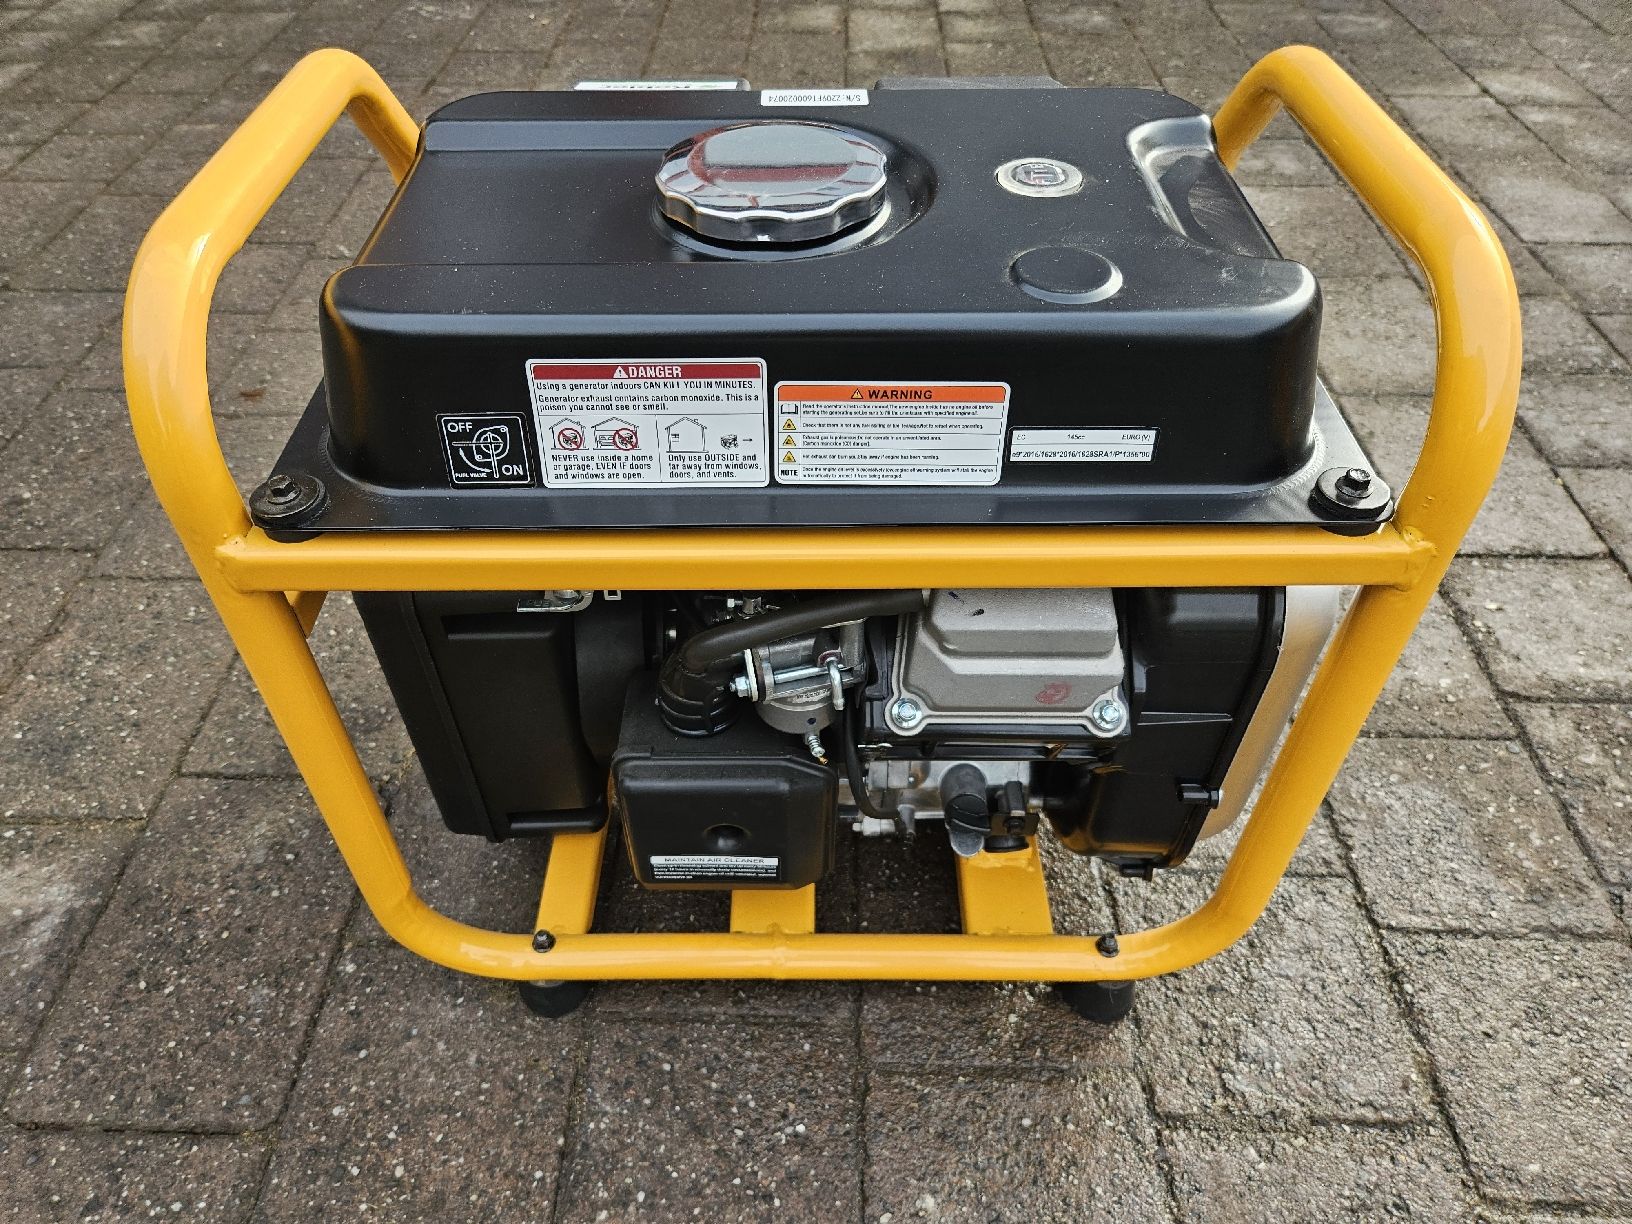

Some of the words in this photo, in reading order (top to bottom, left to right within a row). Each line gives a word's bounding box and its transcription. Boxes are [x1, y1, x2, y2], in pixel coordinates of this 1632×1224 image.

[628, 366, 682, 378] DANGER
[536, 382, 560, 391] Using
[570, 382, 609, 391] generator
[611, 381, 642, 389] indoors
[643, 381, 661, 389] CAN
[684, 381, 702, 389] YOU
[704, 381, 712, 389] IN
[715, 380, 756, 389] MINUTES.
[539, 395, 579, 403] Generator
[614, 394, 649, 402] contains
[651, 394, 679, 402] carbon
[681, 394, 724, 402] monoxide.
[868, 389, 933, 400] WARNING
[540, 404, 567, 412] poison
[570, 404, 584, 412] you
[586, 403, 613, 411] cannot
[643, 403, 669, 411] smell.
[447, 422, 473, 432] OFF
[597, 454, 622, 462] inside
[631, 454, 653, 462] home
[668, 455, 686, 463] Only
[704, 454, 740, 462] OUTSIDE
[742, 454, 757, 462] and
[502, 465, 524, 476] ON
[670, 470, 694, 479] doors,
[697, 470, 711, 478] and
[713, 470, 737, 478] vents.
[554, 472, 569, 480] and
[571, 472, 605, 480] windows
[607, 472, 620, 480] are
[622, 472, 645, 481] open.
